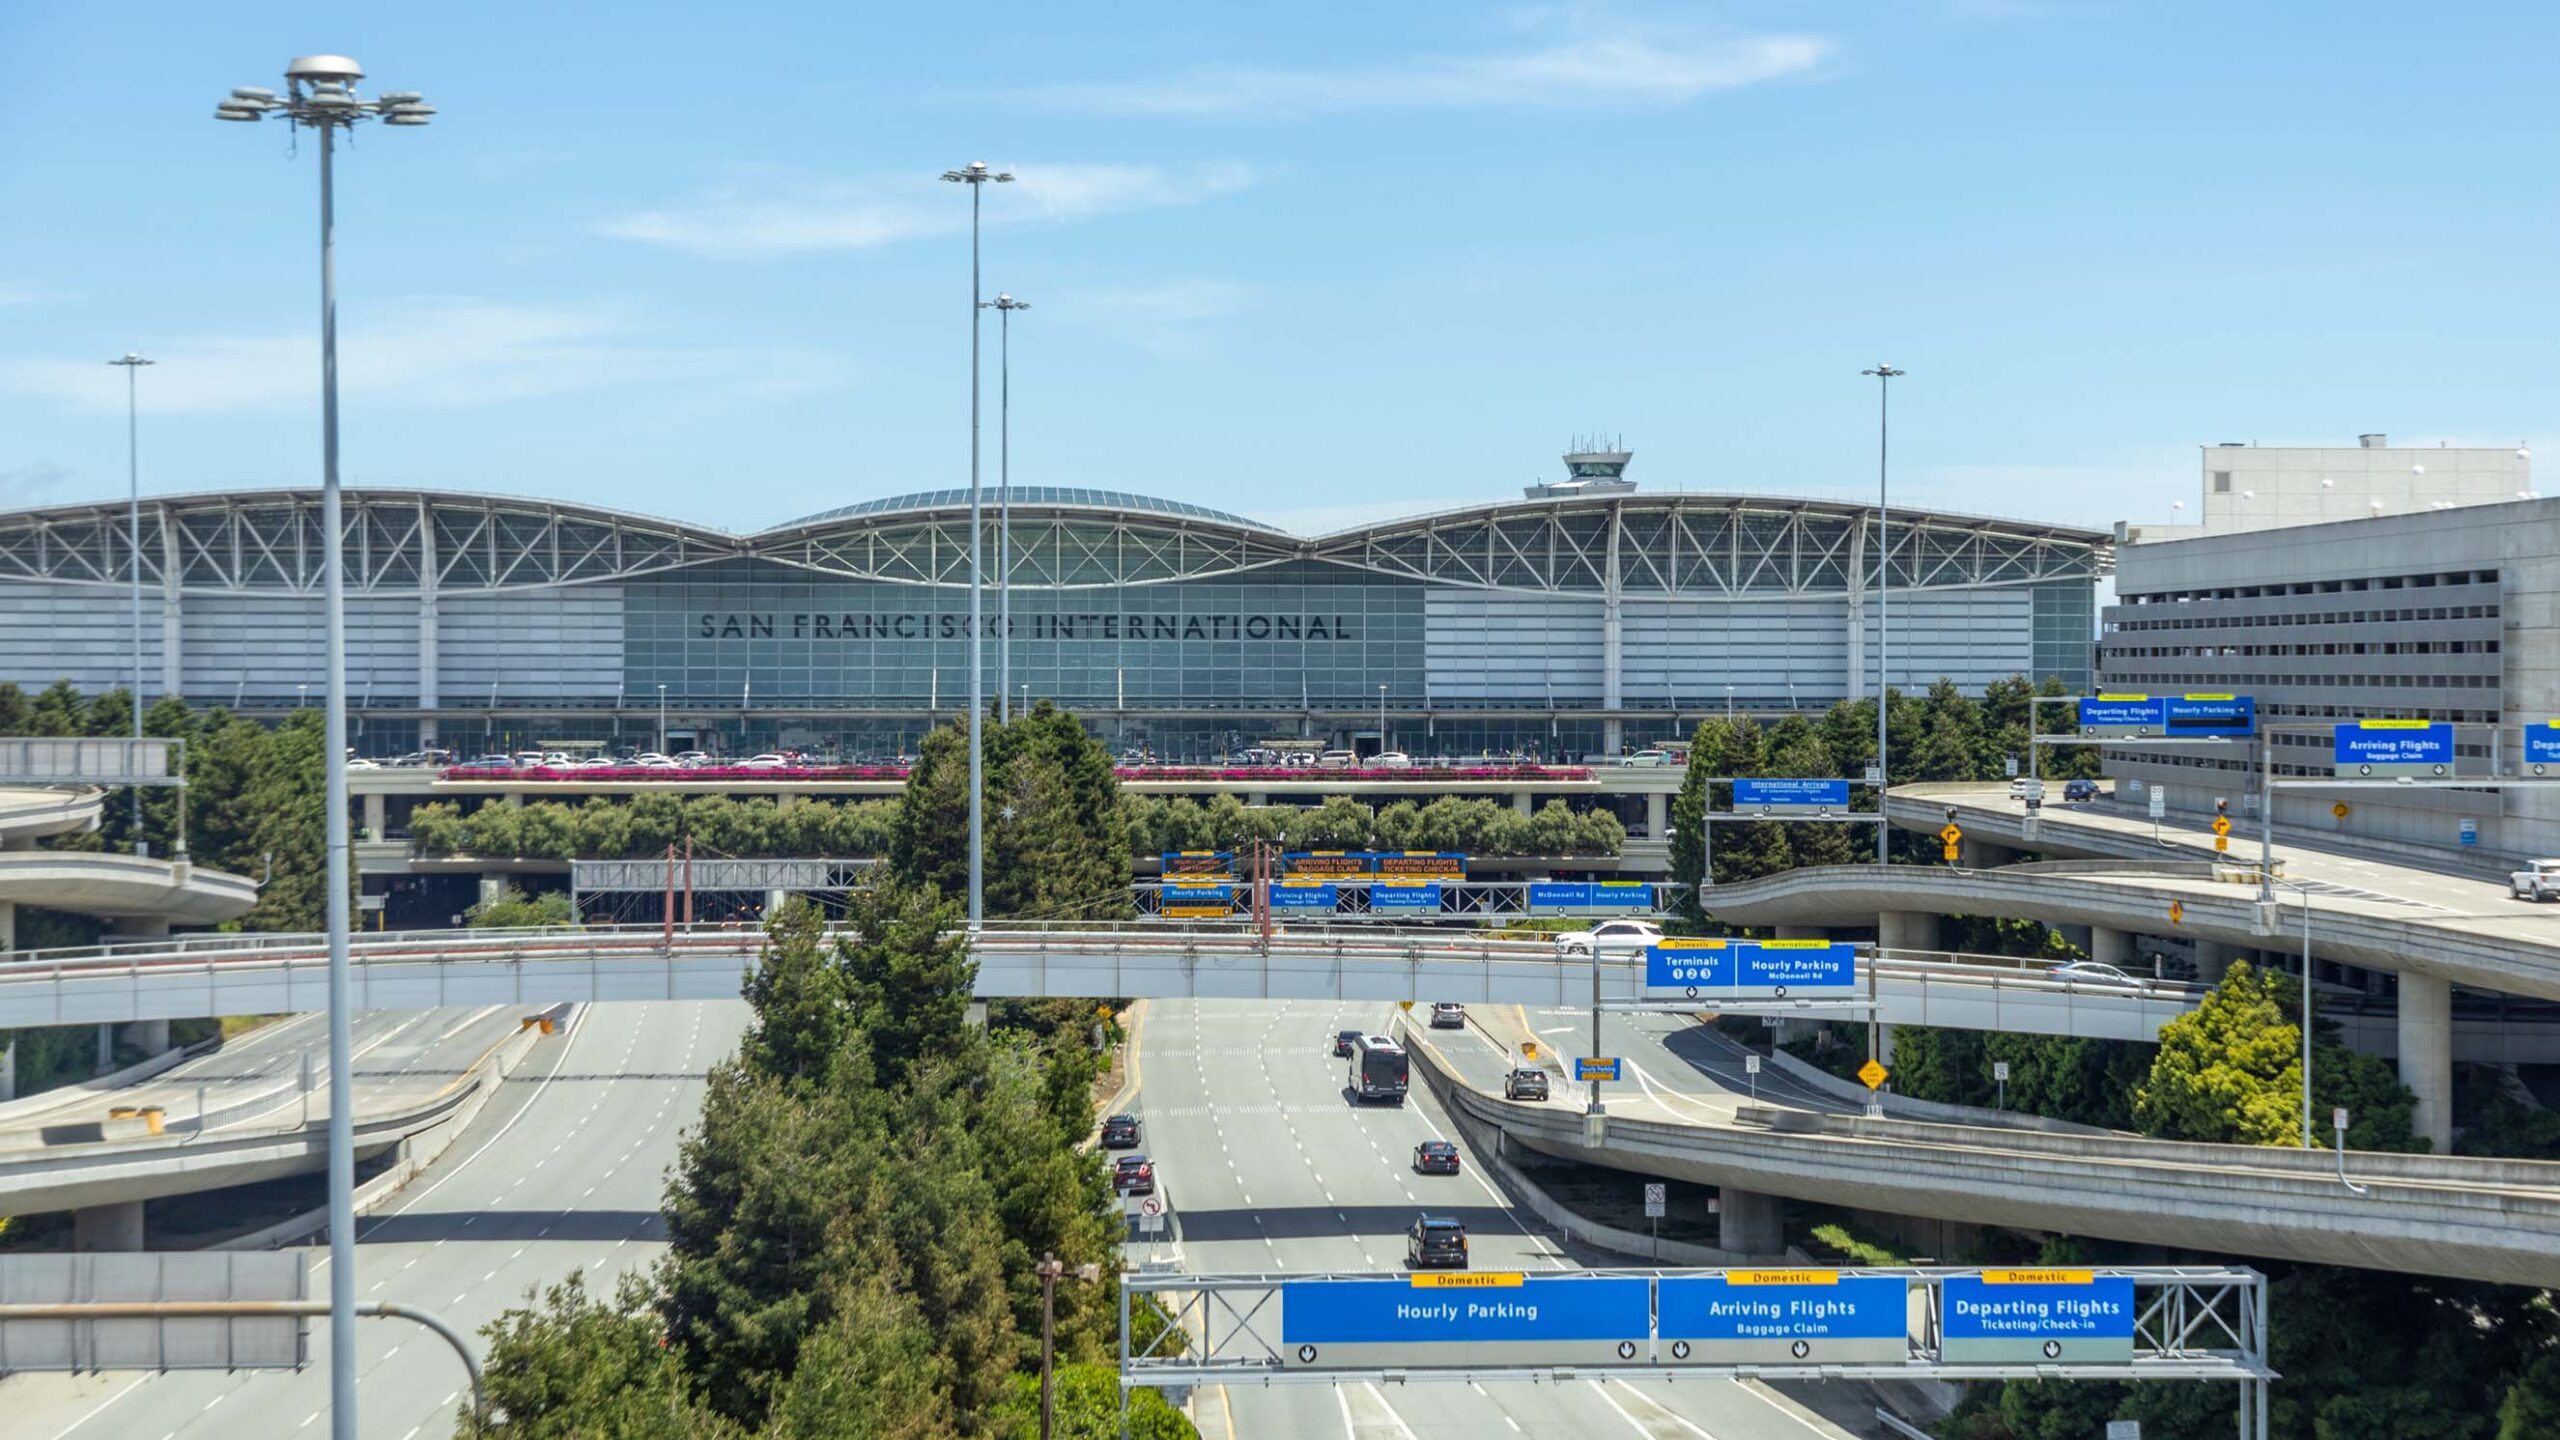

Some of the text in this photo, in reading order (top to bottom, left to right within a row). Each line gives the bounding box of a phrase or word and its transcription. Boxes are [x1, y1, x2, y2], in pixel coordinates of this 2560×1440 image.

[701, 614, 1351, 640] SAN FRANCISCO INTERNATIONAL
[2086, 707, 2159, 716] Departing Flights
[2172, 706, 2235, 715] Hourly Parking
[2350, 740, 2440, 752] Arriving Flights
[2366, 752, 2400, 760] Baggage
[1295, 858, 1363, 866] ARRIVING FLIGHTS
[1383, 858, 1458, 866] DEPARTING FLIGHTS
[1336, 865, 1360, 873] CLAIM
[1172, 889, 1223, 897] Hourly Parking
[1275, 892, 1329, 900] Arriving Flights
[1376, 892, 1435, 900] Departing Flights
[1596, 891, 1647, 899] Hourly Parking
[1665, 956, 1719, 966] Terminals
[1752, 960, 1839, 972] Hourly Parking
[1438, 1275, 1497, 1285] Domestic
[1753, 1273, 1811, 1283] Domestic
[2009, 1272, 2067, 1281] Domestic
[1397, 1302, 1538, 1321] Hourly Parking
[1710, 1300, 1856, 1319] Arriving Flights
[1956, 1300, 2120, 1317] Departing Flights
[1737, 1323, 1828, 1335] Baggage Claim
[1981, 1319, 2096, 1331] Ticketing/Check-in
